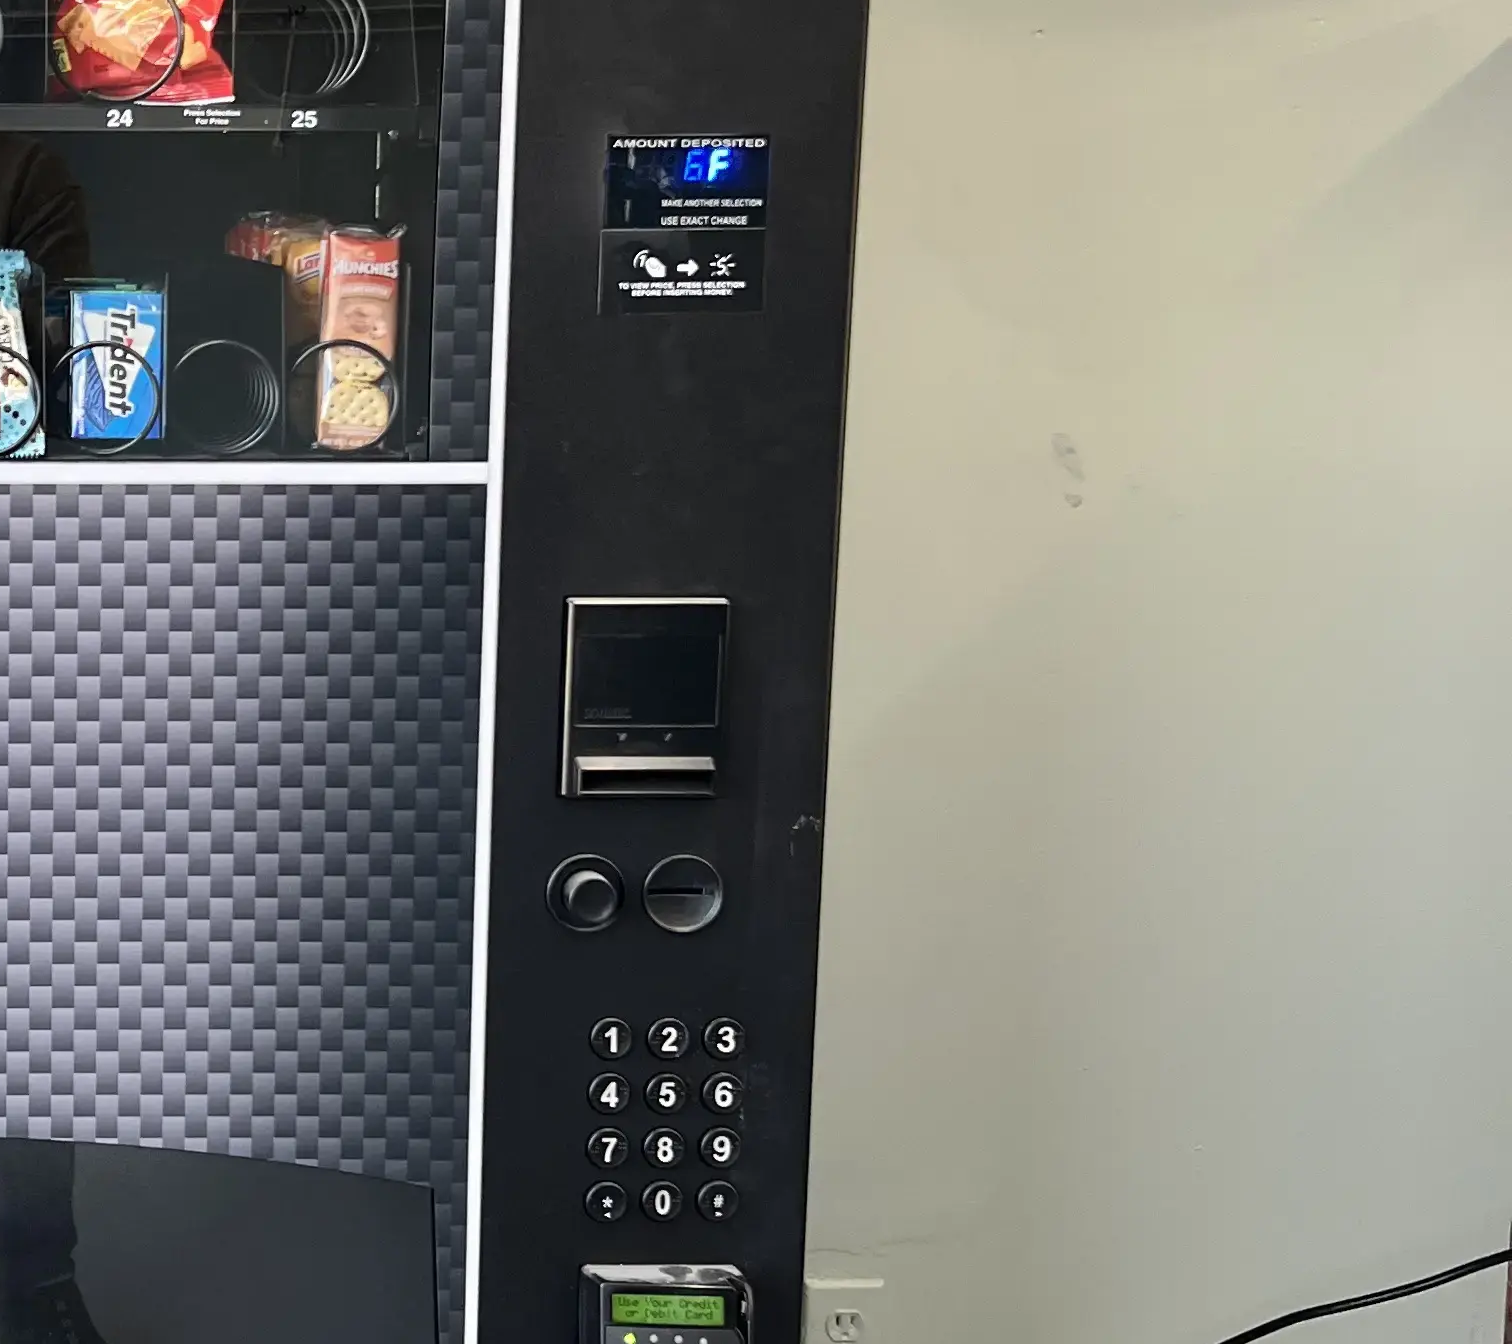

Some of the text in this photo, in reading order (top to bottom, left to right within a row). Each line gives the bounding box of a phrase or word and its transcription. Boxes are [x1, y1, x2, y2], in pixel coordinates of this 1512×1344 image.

[106, 109, 133, 128] 24
[206, 109, 241, 117] Selection
[291, 110, 318, 129] 25
[195, 117, 230, 126] For Price
[613, 138, 767, 149] AMOUNT DEPOSITED
[661, 198, 763, 207] MAKE ANOTHER SELECTION
[660, 215, 748, 226] USE EXACT CHANGE
[333, 259, 399, 278] MUNCHIES
[702, 281, 746, 289] SELECTION
[108, 307, 136, 417] Trident
[604, 1026, 736, 1054] 1 2 3
[600, 1081, 733, 1108] 4 5 6
[601, 1135, 731, 1163] 7 8 9
[654, 1190, 671, 1216] 0
[617, 1297, 640, 1307] Use
[685, 1309, 714, 1320] Card
